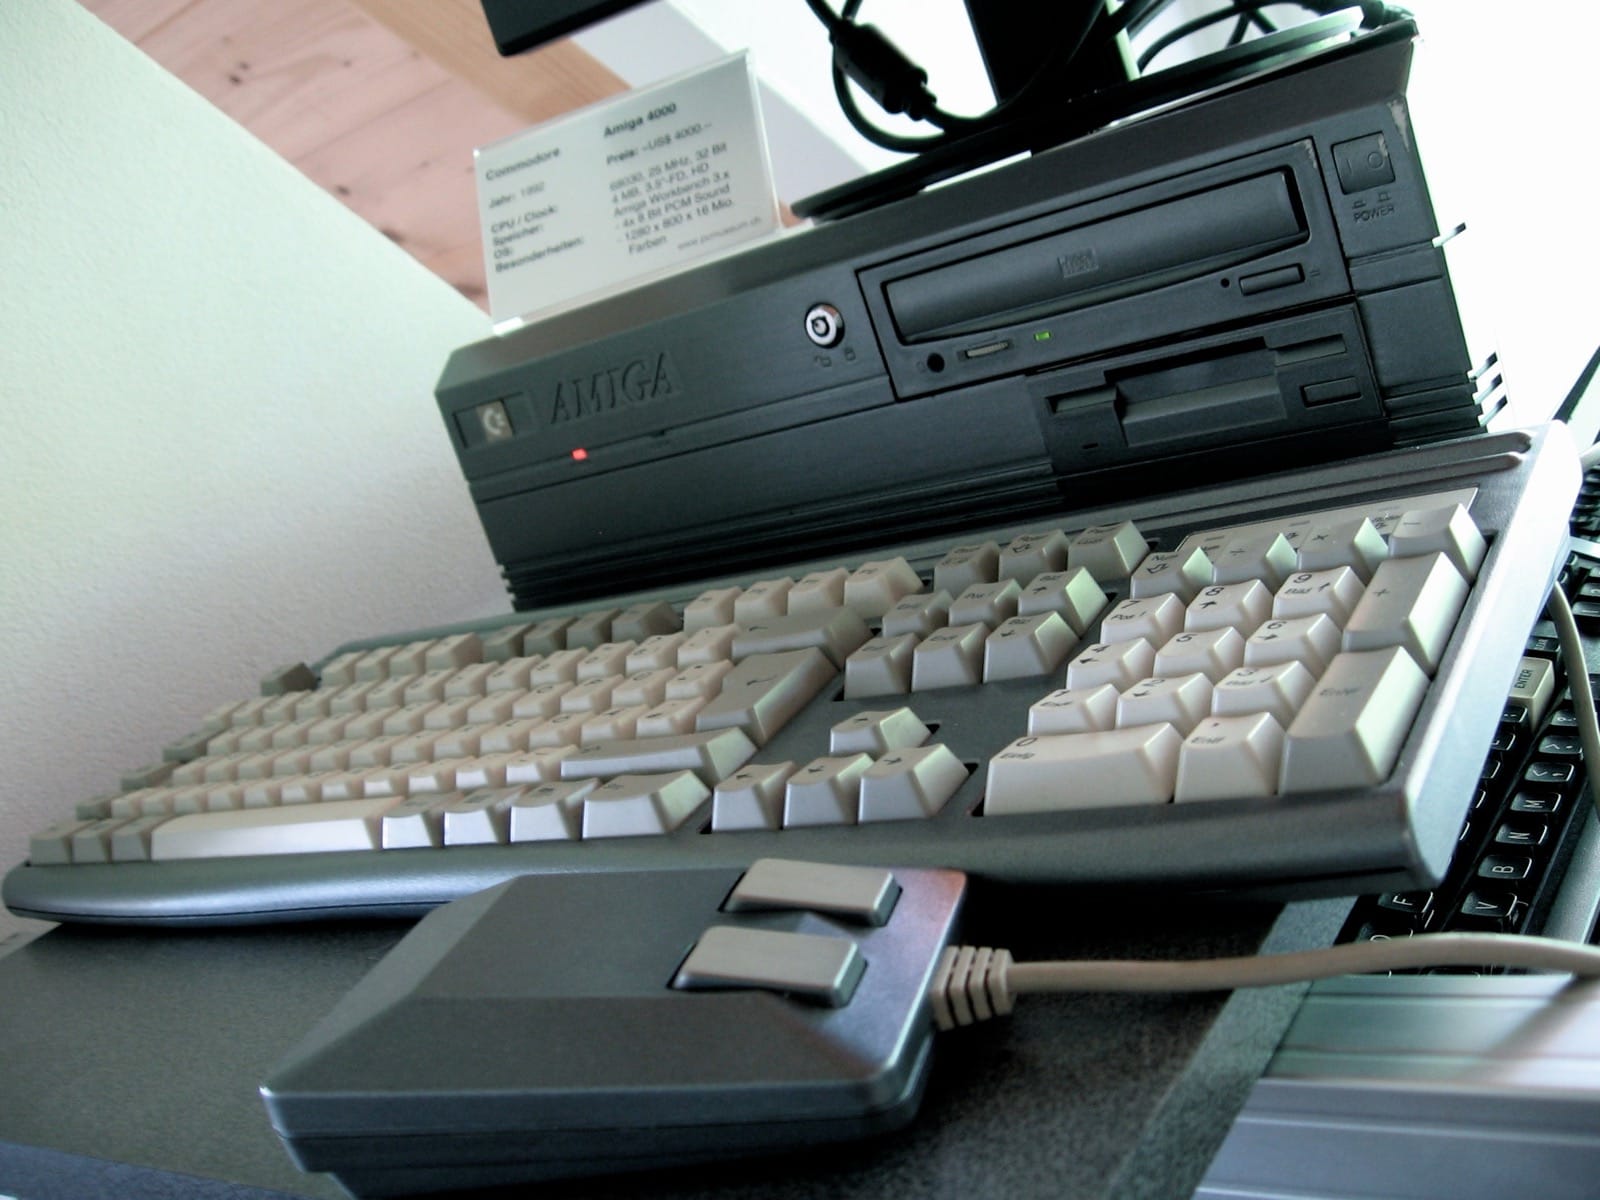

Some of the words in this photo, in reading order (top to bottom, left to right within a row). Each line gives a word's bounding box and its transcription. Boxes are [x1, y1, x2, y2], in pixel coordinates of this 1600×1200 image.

[604, 115, 643, 138] Amiga
[646, 101, 677, 121] 4000
[695, 146, 709, 161] 32
[711, 140, 728, 156] Bit
[485, 147, 560, 181] Commodore
[614, 199, 647, 218] Amiga
[648, 175, 711, 206] Workbench
[647, 206, 662, 221] Bit
[664, 194, 692, 214] PCM
[694, 182, 731, 204] Sound
[1352, 204, 1396, 223] POWER
[491, 217, 515, 234] CPU
[628, 233, 668, 256] Farben
[550, 352, 676, 425] AMIGA
[1293, 573, 1313, 584] 9
[1205, 586, 1225, 597] 8
[1120, 599, 1142, 609] 7
[1267, 620, 1288, 630] 6
[1176, 633, 1199, 643] 5
[1514, 668, 1533, 689] ENTER
[1524, 799, 1546, 809] M
[1508, 831, 1531, 840] N
[1491, 865, 1515, 874] B
[1392, 894, 1414, 906] F
[1475, 900, 1499, 910] V
